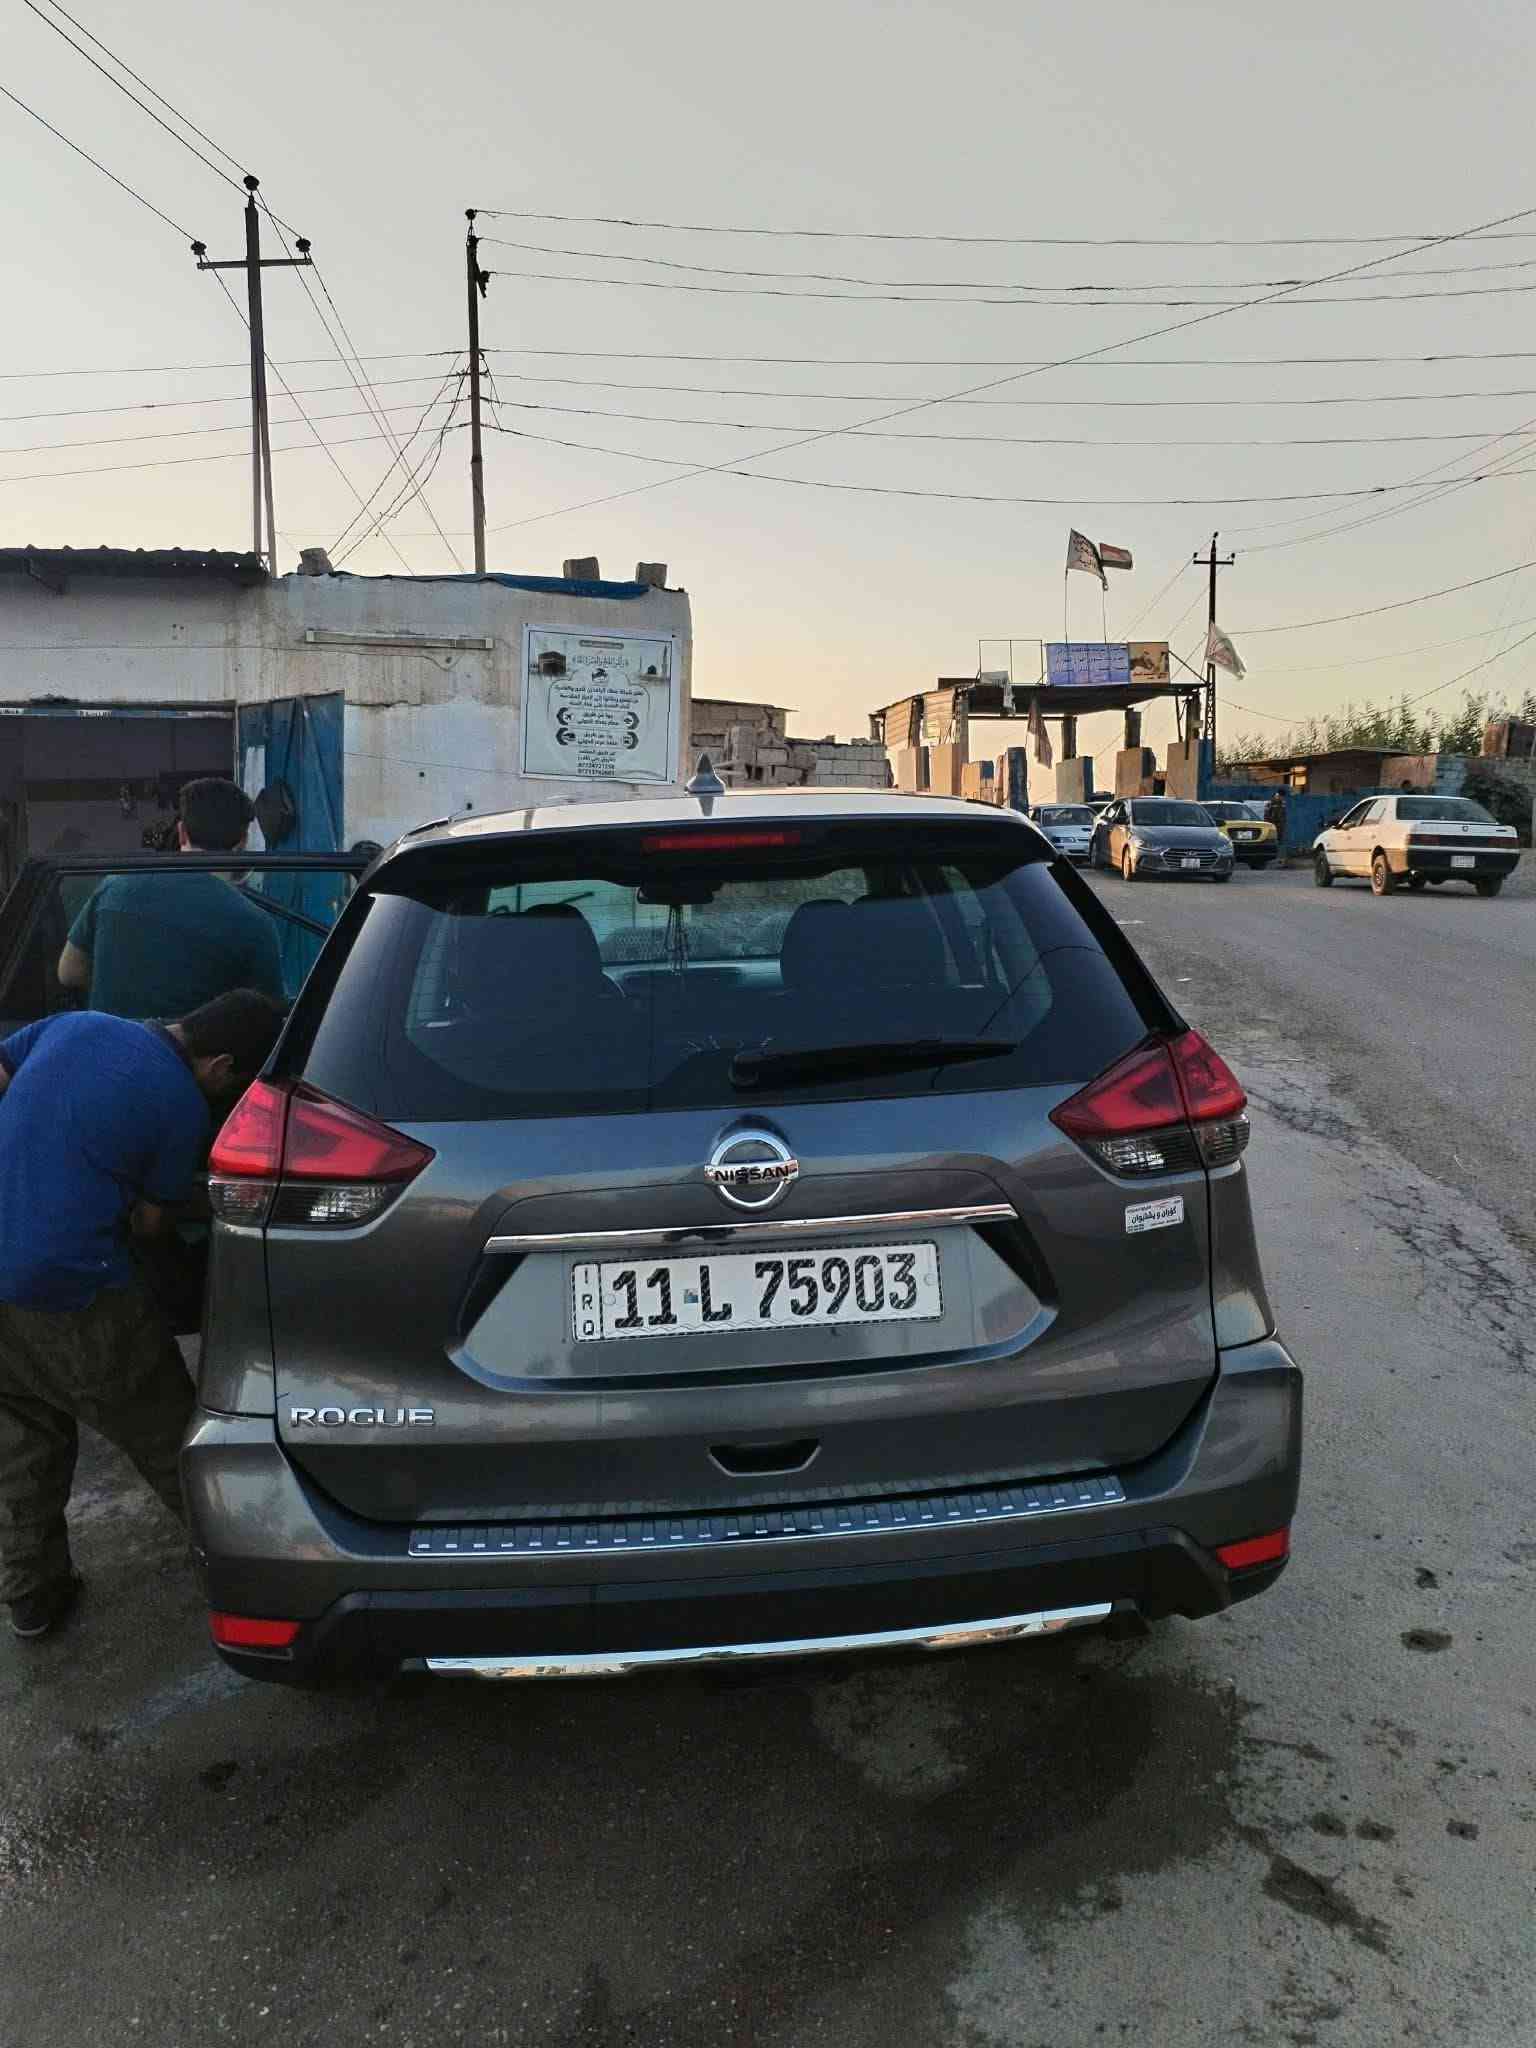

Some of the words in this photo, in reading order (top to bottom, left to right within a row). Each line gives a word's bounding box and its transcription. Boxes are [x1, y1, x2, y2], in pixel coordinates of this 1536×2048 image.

[714, 1165, 790, 1182] NISSAN
[611, 1268, 678, 1329] 11
[754, 1252, 917, 1319] 75903
[288, 1406, 434, 1428] ROGUE
